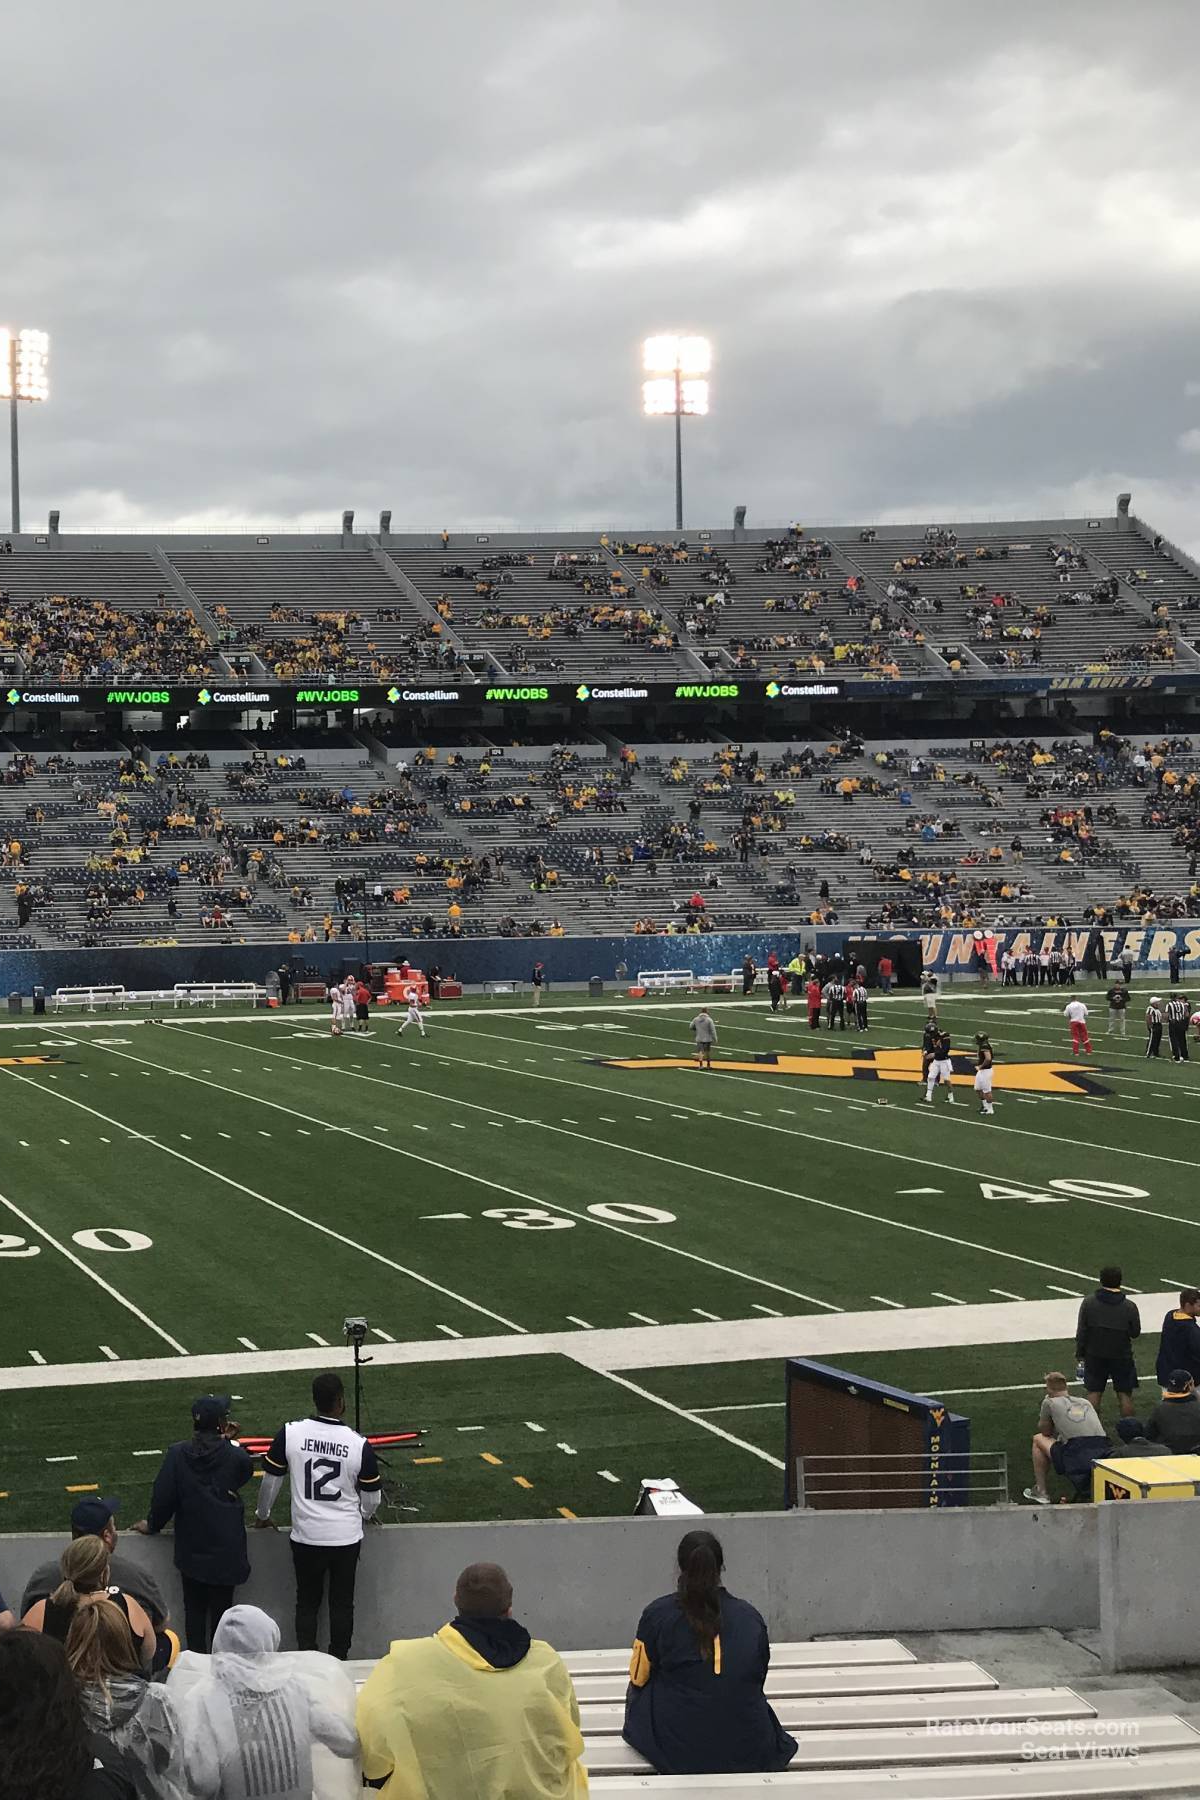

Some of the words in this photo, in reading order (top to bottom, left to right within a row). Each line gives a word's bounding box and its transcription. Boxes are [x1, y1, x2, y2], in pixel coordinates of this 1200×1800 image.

[296, 690, 359, 702] #WVJOBS
[402, 690, 458, 700] Constellium
[486, 688, 548, 700] #WVJOBS
[592, 688, 648, 698] Constellium
[675, 686, 738, 697] #WVJOBS
[781, 686, 838, 695] Constellium
[22, 692, 79, 703] Constellium
[107, 692, 170, 703] #WVJOBS
[213, 692, 269, 702] Constellium
[979, 1178, 1150, 1204] 40
[481, 1202, 677, 1230] 30
[301, 1438, 349, 1458] JENNINGS
[304, 1458, 341, 1501] 12
